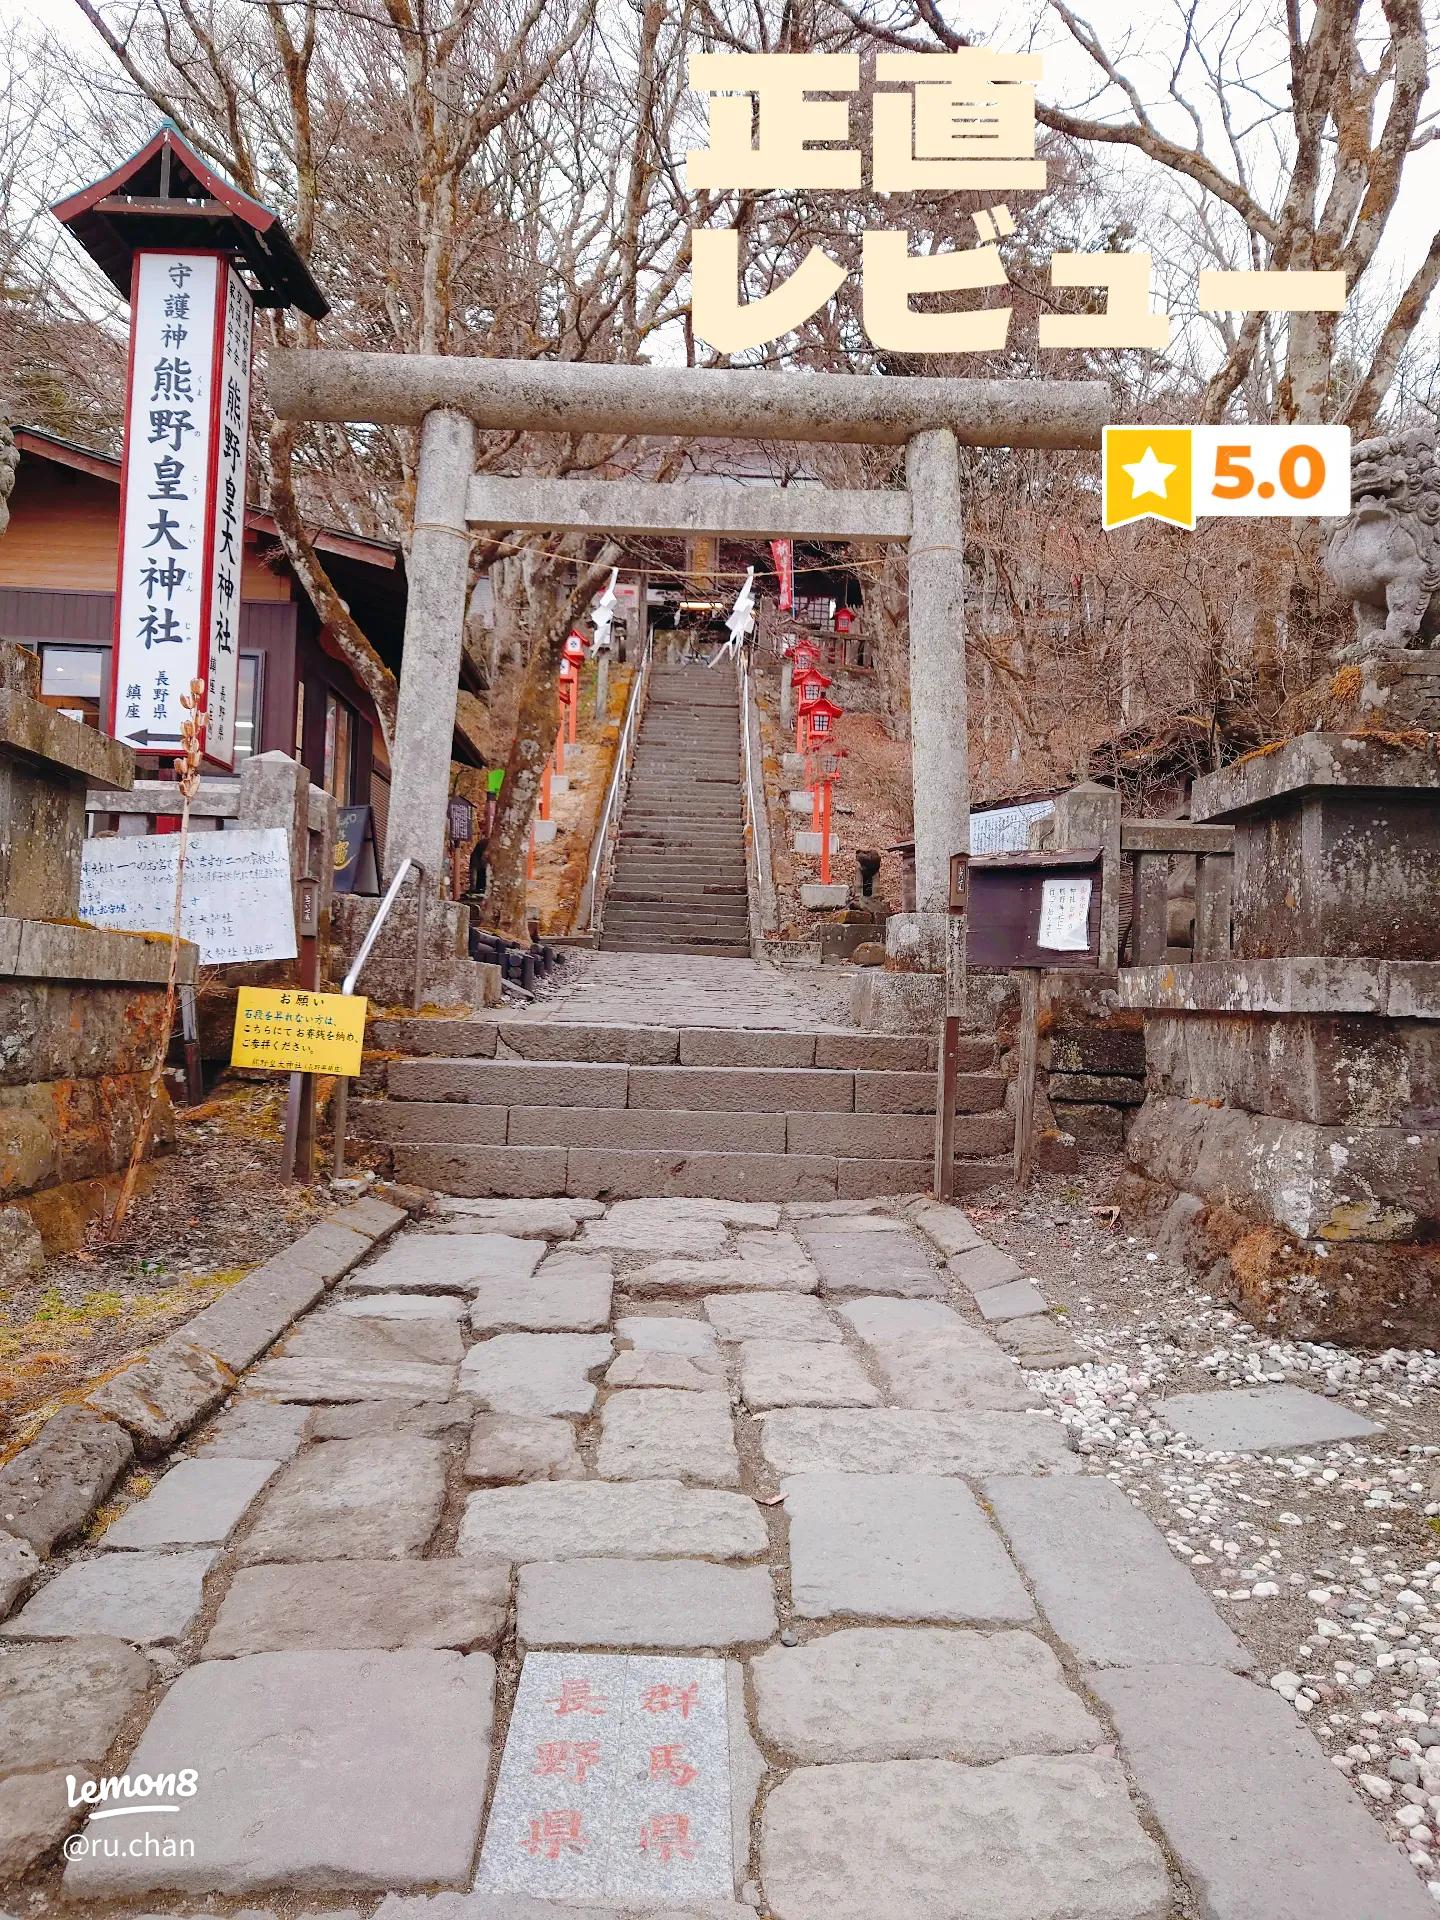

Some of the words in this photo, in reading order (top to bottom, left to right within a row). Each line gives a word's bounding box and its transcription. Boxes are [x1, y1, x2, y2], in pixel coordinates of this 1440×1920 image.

[160, 262, 193, 350] 守護神
[136, 356, 195, 650] 熊野皇大神社
[215, 375, 241, 655] 熊野皇大神社
[125, 683, 142, 719] 鎮座
[152, 670, 170, 720] 長野県
[243, 1024, 293, 1037] こちらにて
[280, 993, 325, 1007] お願い
[242, 1038, 315, 1055] ご参拝ください。
[519, 1678, 608, 1861] 長野県
[640, 1680, 701, 1868] 群馬県
